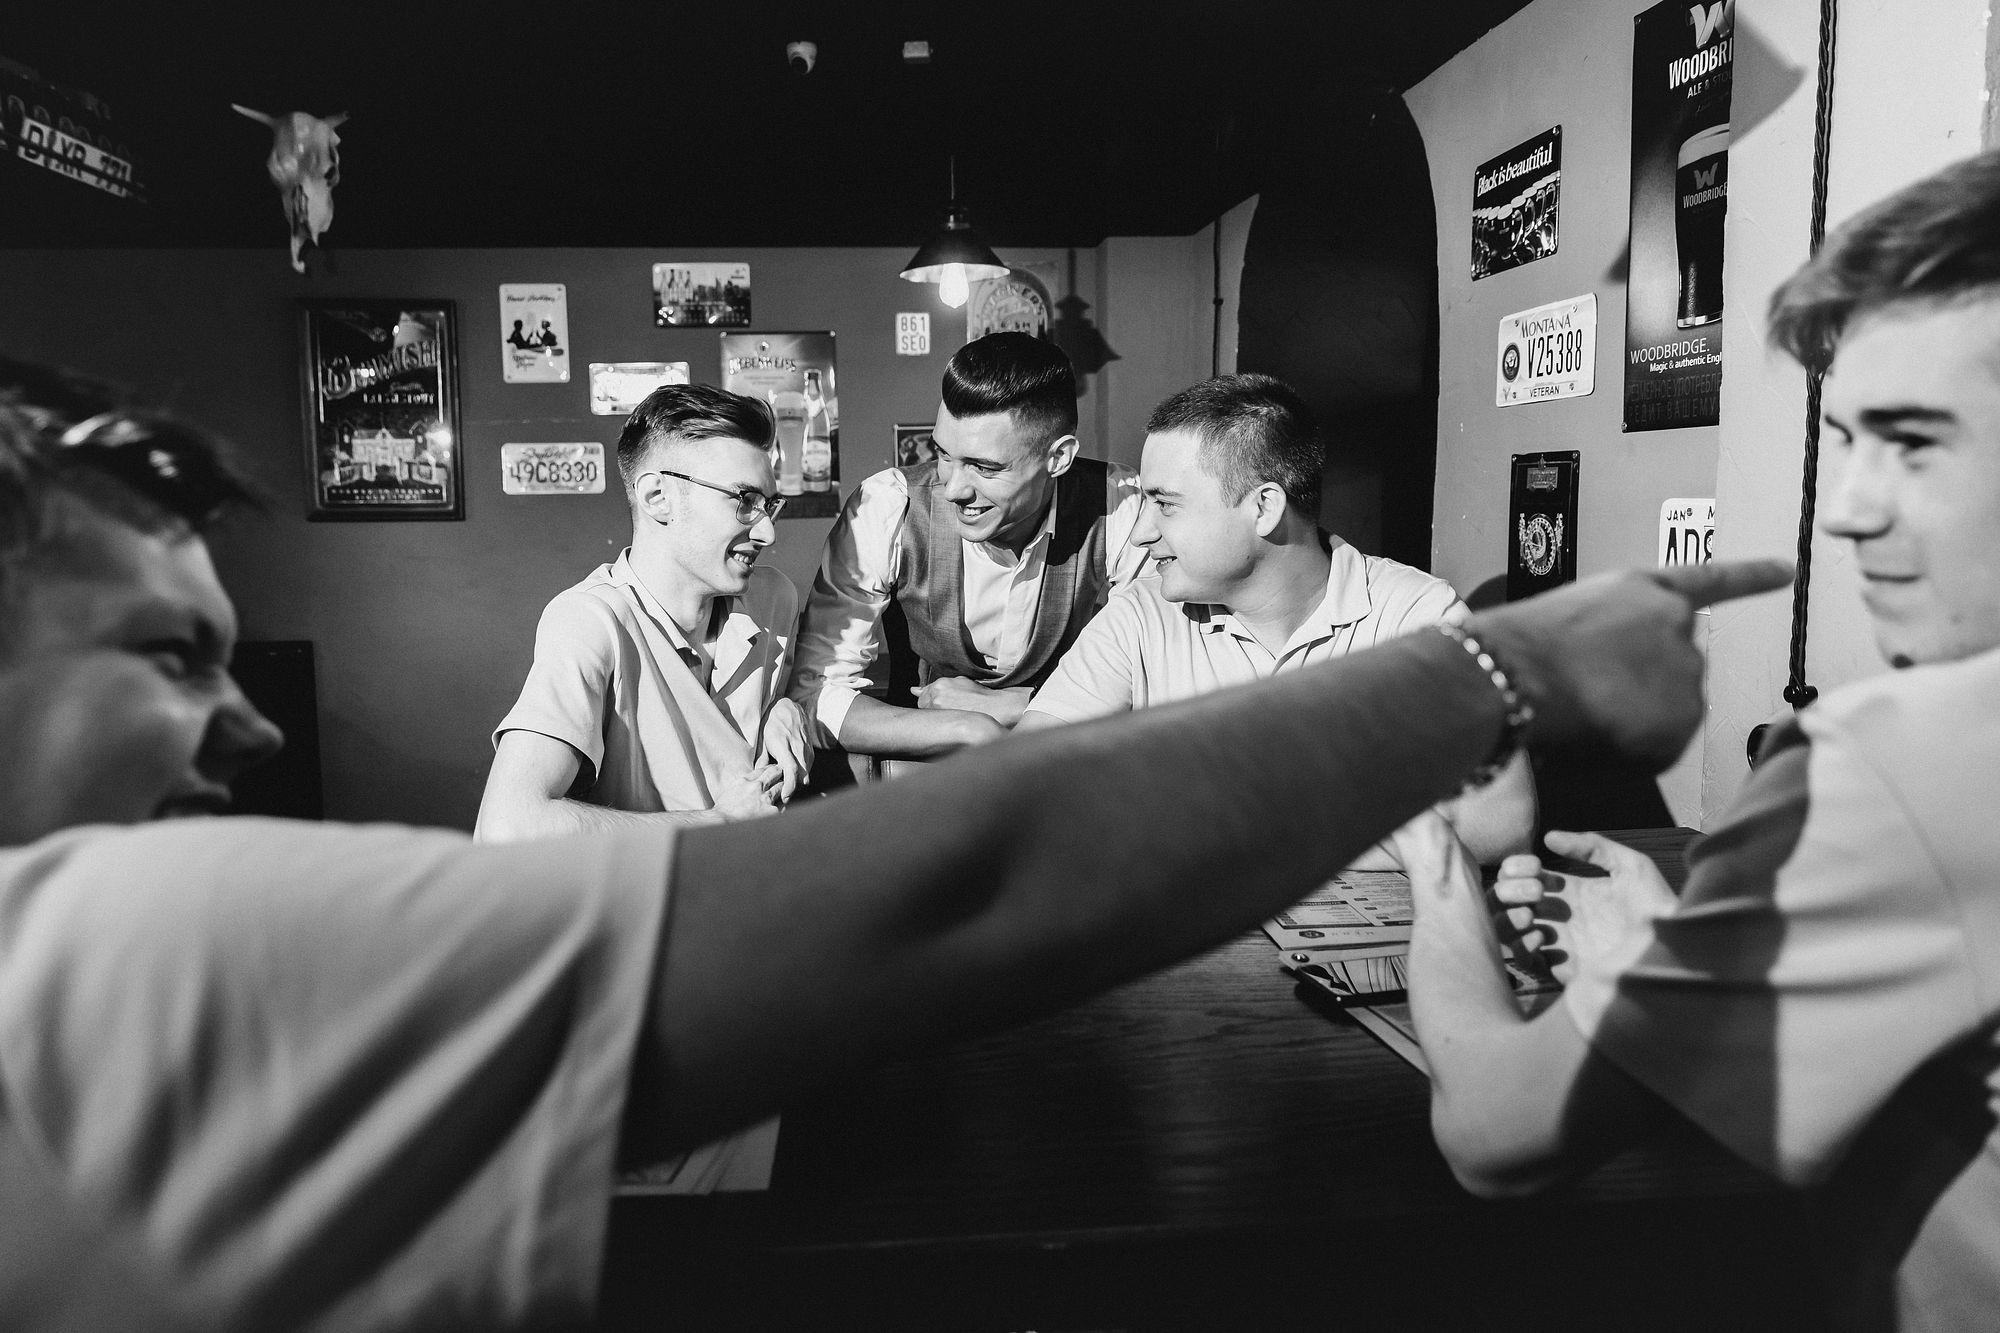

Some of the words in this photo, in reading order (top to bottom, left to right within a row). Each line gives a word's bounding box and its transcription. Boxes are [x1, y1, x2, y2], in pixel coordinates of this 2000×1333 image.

[1687, 82, 1702, 99] ALE
[1477, 169, 1498, 197] Black
[1498, 166, 1506, 185] is
[1506, 142, 1553, 182] beautiful
[1683, 182, 1728, 209] WOODBRIDGE
[901, 316, 925, 332] 861
[1522, 314, 1571, 338] MONTANA
[1528, 329, 1582, 378] V25388
[1630, 337, 1710, 364] WOODBRIDGE.
[1649, 361, 1668, 374] Magic
[1669, 360, 1675, 369] &
[1675, 355, 1706, 369] authentic
[1530, 386, 1560, 397] VETERAN
[1667, 510, 1686, 521] JAN
